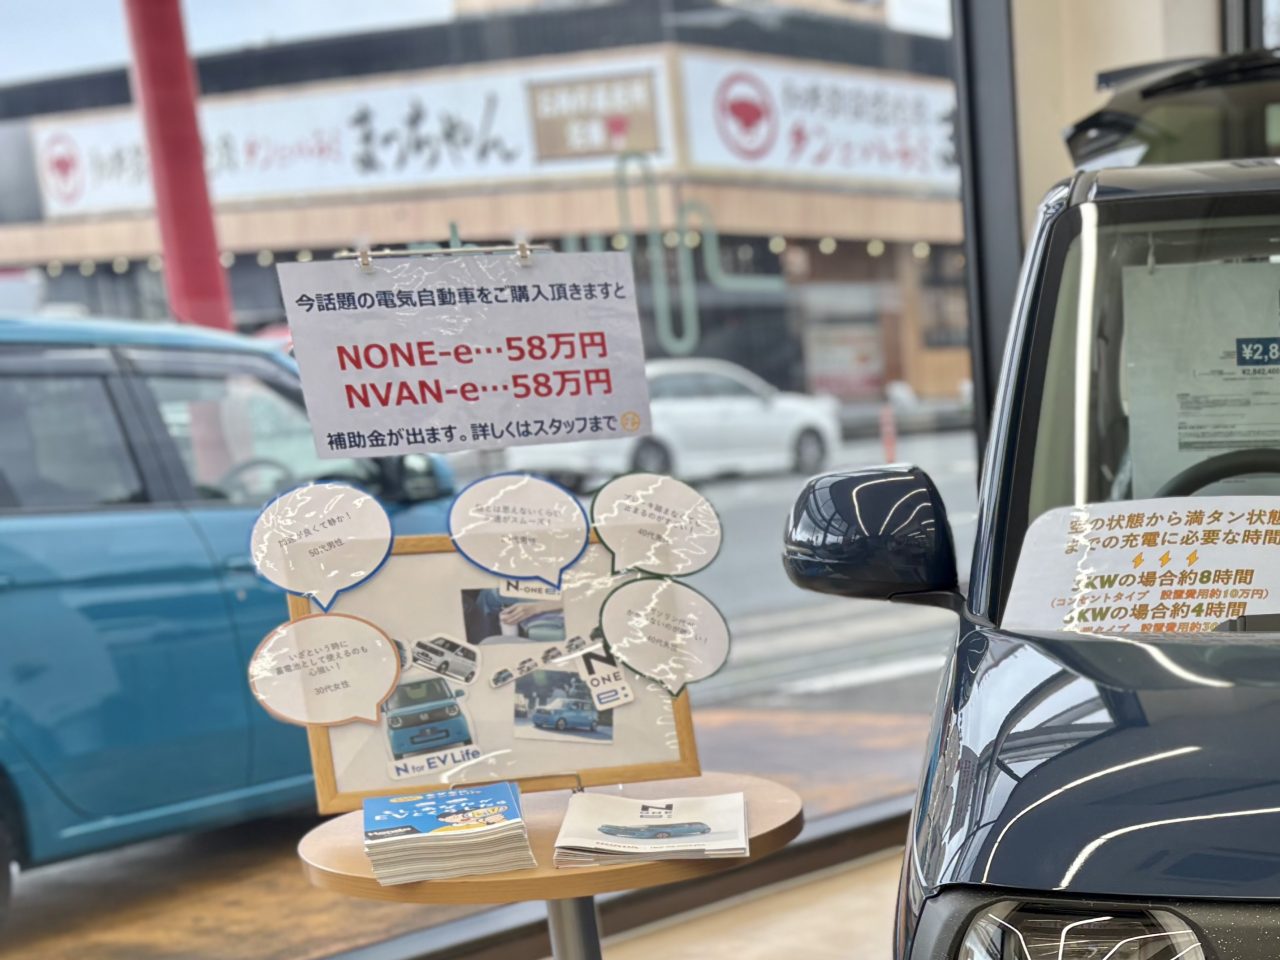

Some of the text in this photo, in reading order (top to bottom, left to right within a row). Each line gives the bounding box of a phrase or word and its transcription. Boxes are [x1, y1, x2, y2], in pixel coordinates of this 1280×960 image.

[295, 281, 626, 313] 今話題の電気自動車をご購入頂きますと
[327, 416, 617, 451] 補助金が出ます。詳しくはスタッフまで
[590, 672, 622, 687] ONE
[426, 754, 448, 769] EV
[450, 748, 480, 764] Life
